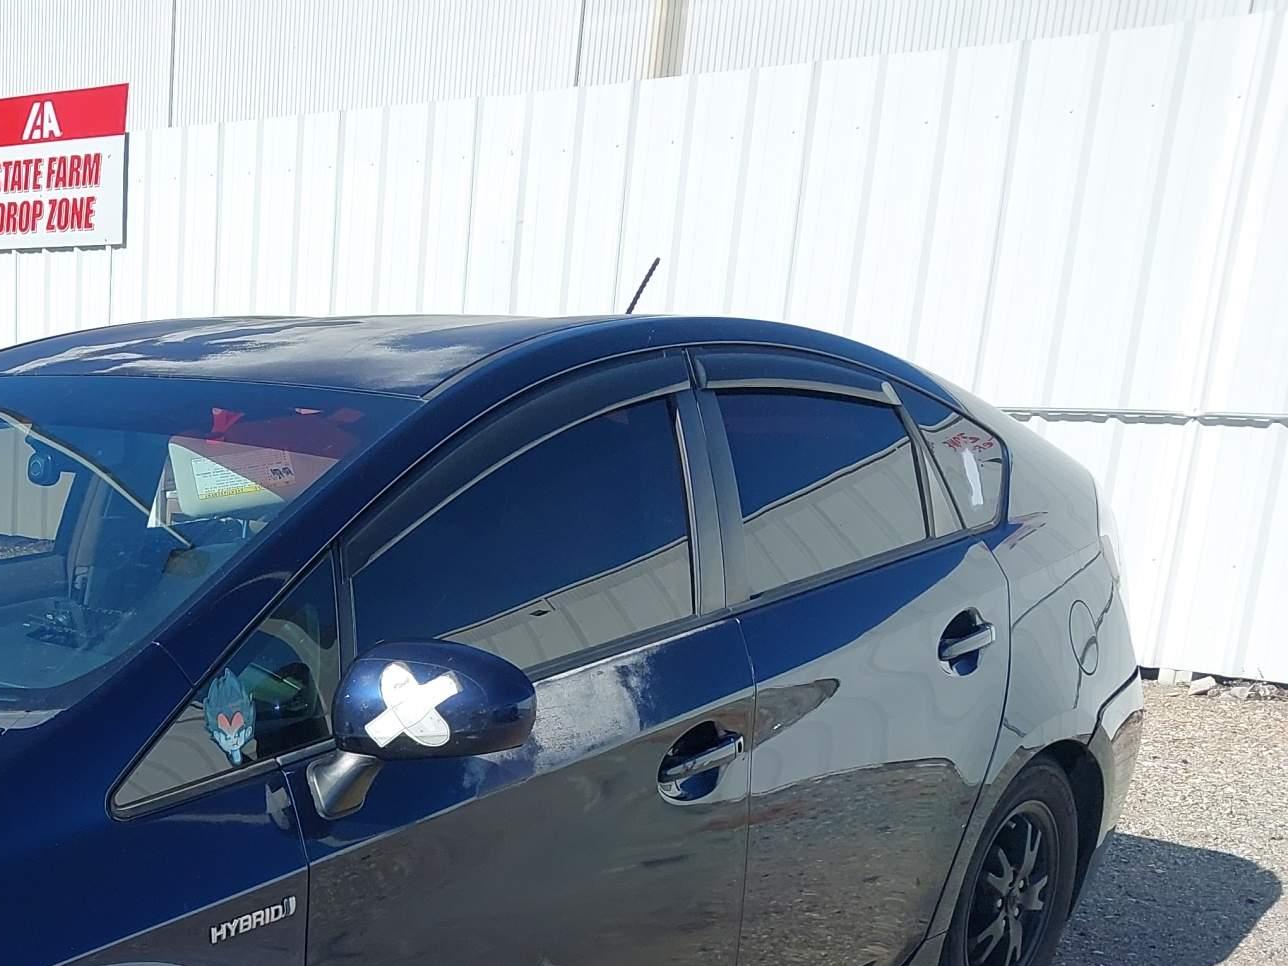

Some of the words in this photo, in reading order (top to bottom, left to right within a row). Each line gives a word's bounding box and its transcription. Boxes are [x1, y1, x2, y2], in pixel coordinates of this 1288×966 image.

[46, 153, 102, 189] FARM
[46, 196, 96, 233] ZONE
[210, 904, 283, 944] HYBRID
